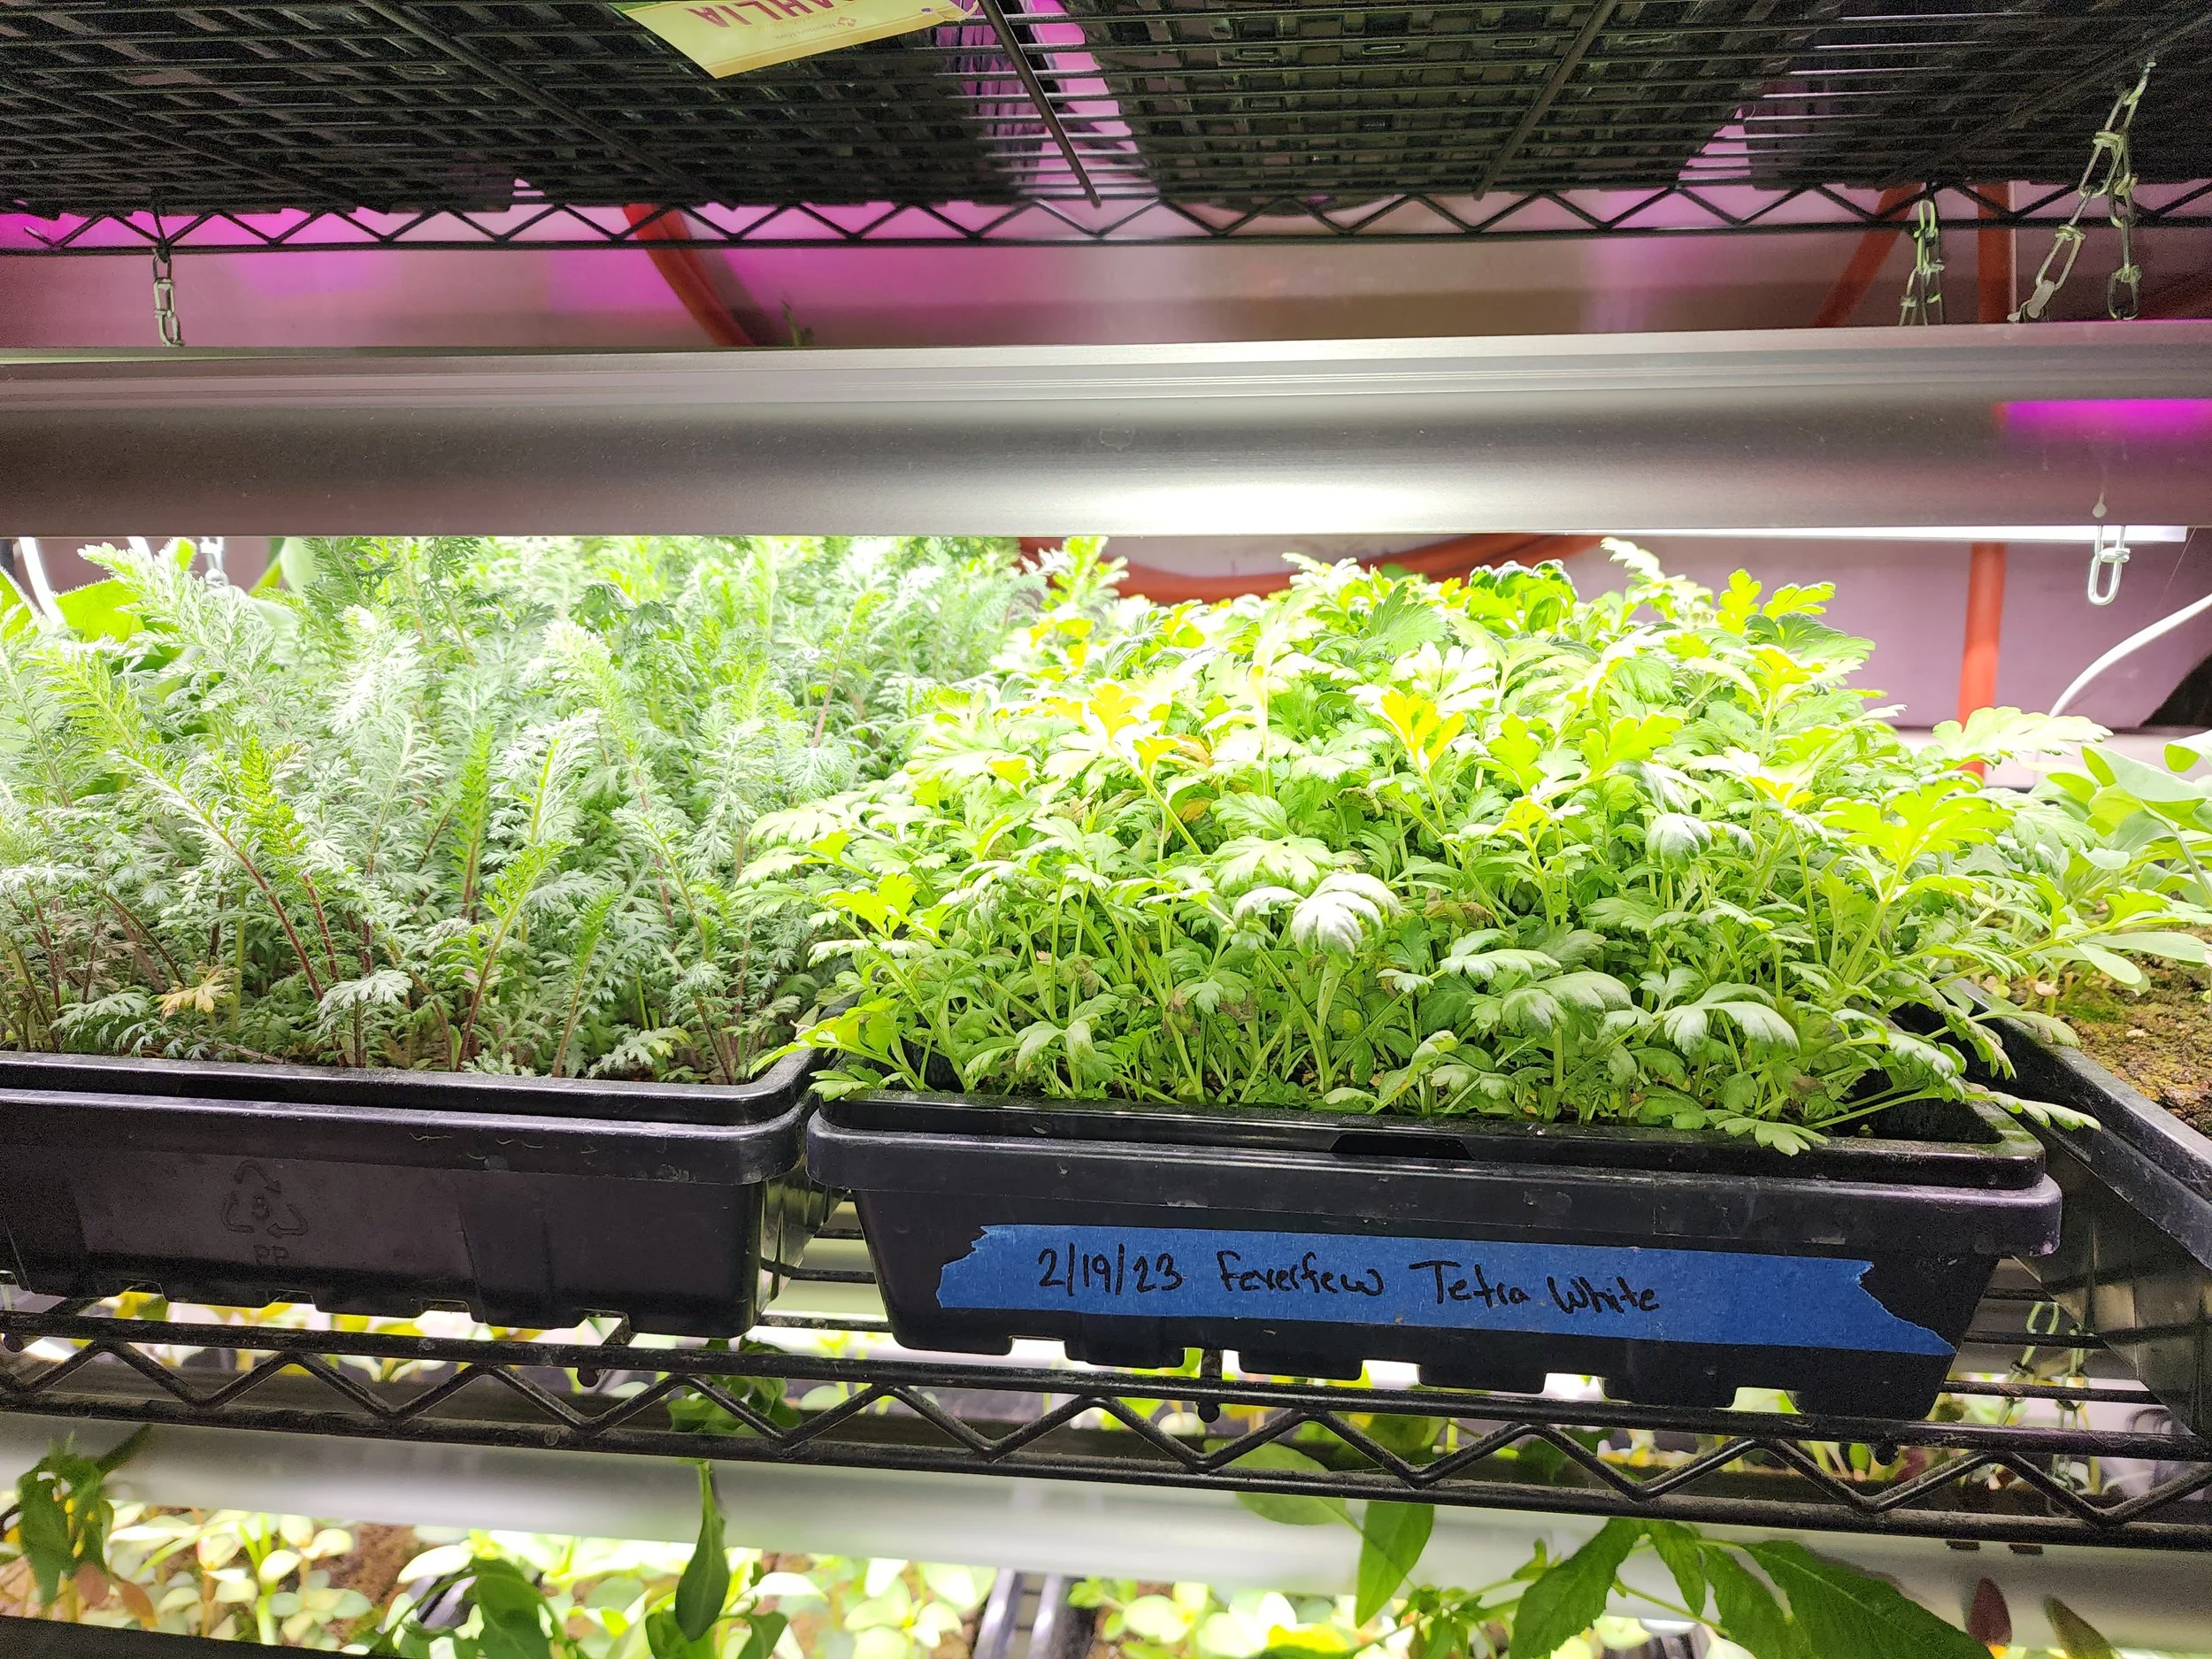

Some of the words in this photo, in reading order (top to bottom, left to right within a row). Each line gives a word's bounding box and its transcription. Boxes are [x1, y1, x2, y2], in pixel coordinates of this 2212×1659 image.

[253, 1244, 290, 1266] PP
[1037, 1241, 1184, 1297] 2/19/23
[1217, 1249, 1385, 1297] Feverfew
[1409, 1260, 1531, 1309] Tetra
[1546, 1275, 1660, 1315] White
